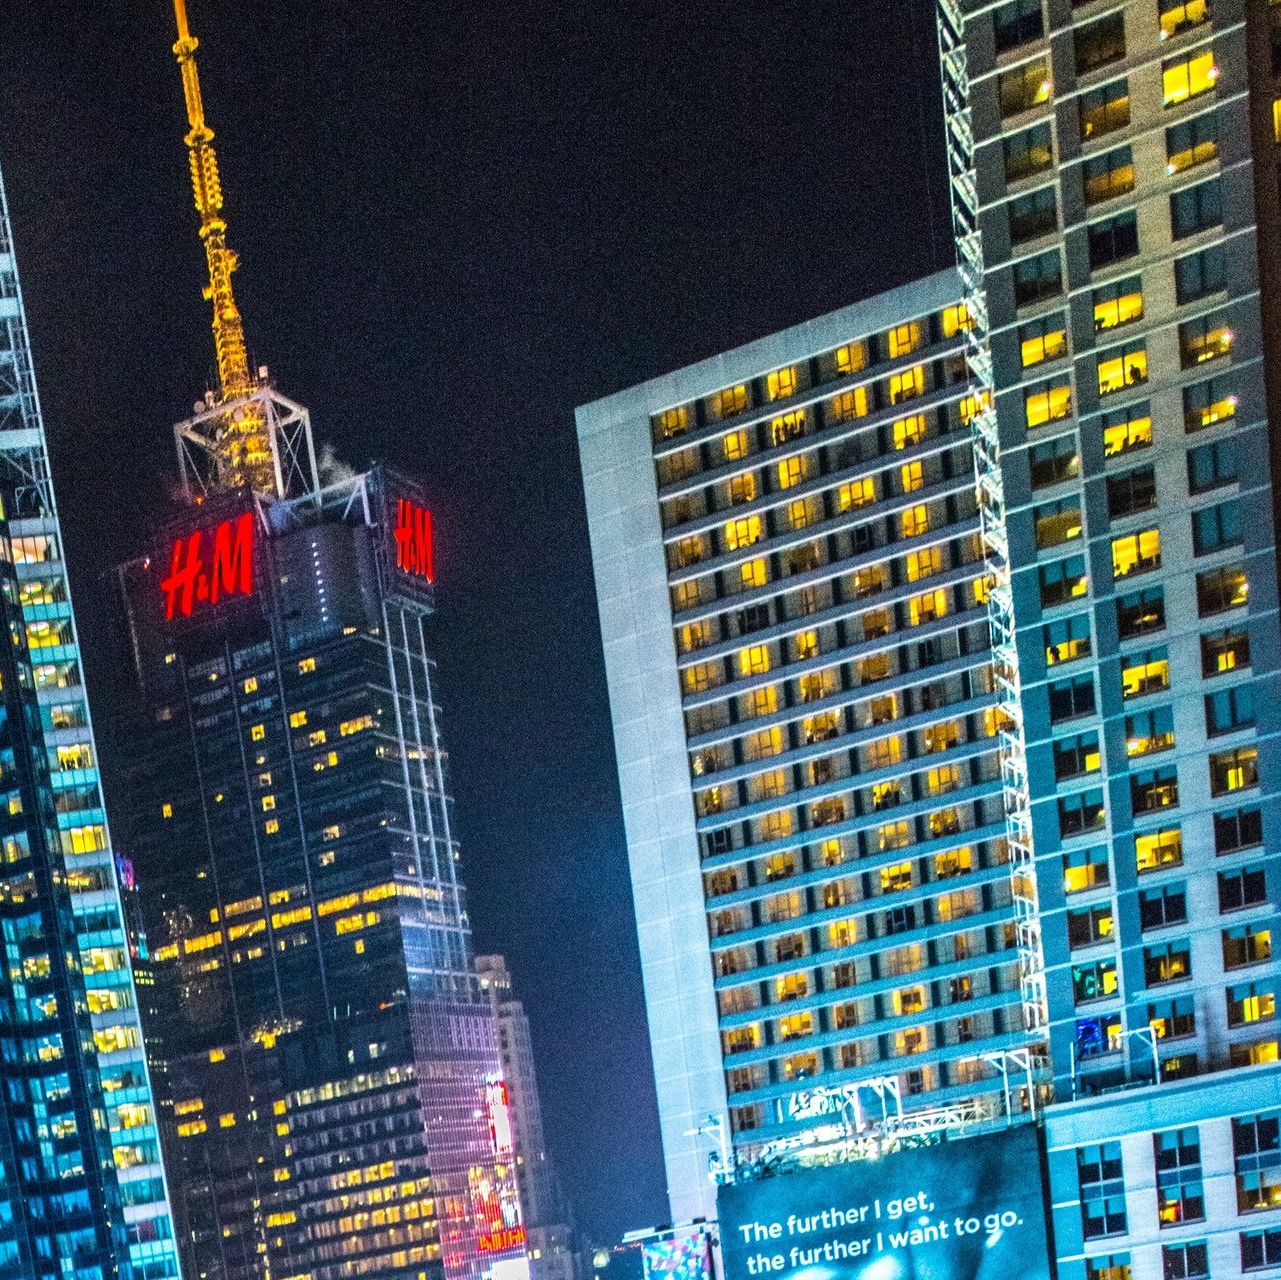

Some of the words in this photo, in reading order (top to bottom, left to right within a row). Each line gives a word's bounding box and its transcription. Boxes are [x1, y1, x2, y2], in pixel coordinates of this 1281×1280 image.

[160, 511, 253, 620] H&M
[393, 498, 432, 584] H&M
[739, 1223, 782, 1244] The
[787, 1204, 869, 1236] further
[874, 1199, 881, 1218] I
[887, 1193, 935, 1219] get,
[747, 1253, 785, 1275] the
[789, 1236, 871, 1267] further
[877, 1231, 883, 1252] I
[888, 1222, 949, 1248] want
[954, 1217, 980, 1236] to
[983, 1209, 1024, 1233] go.
